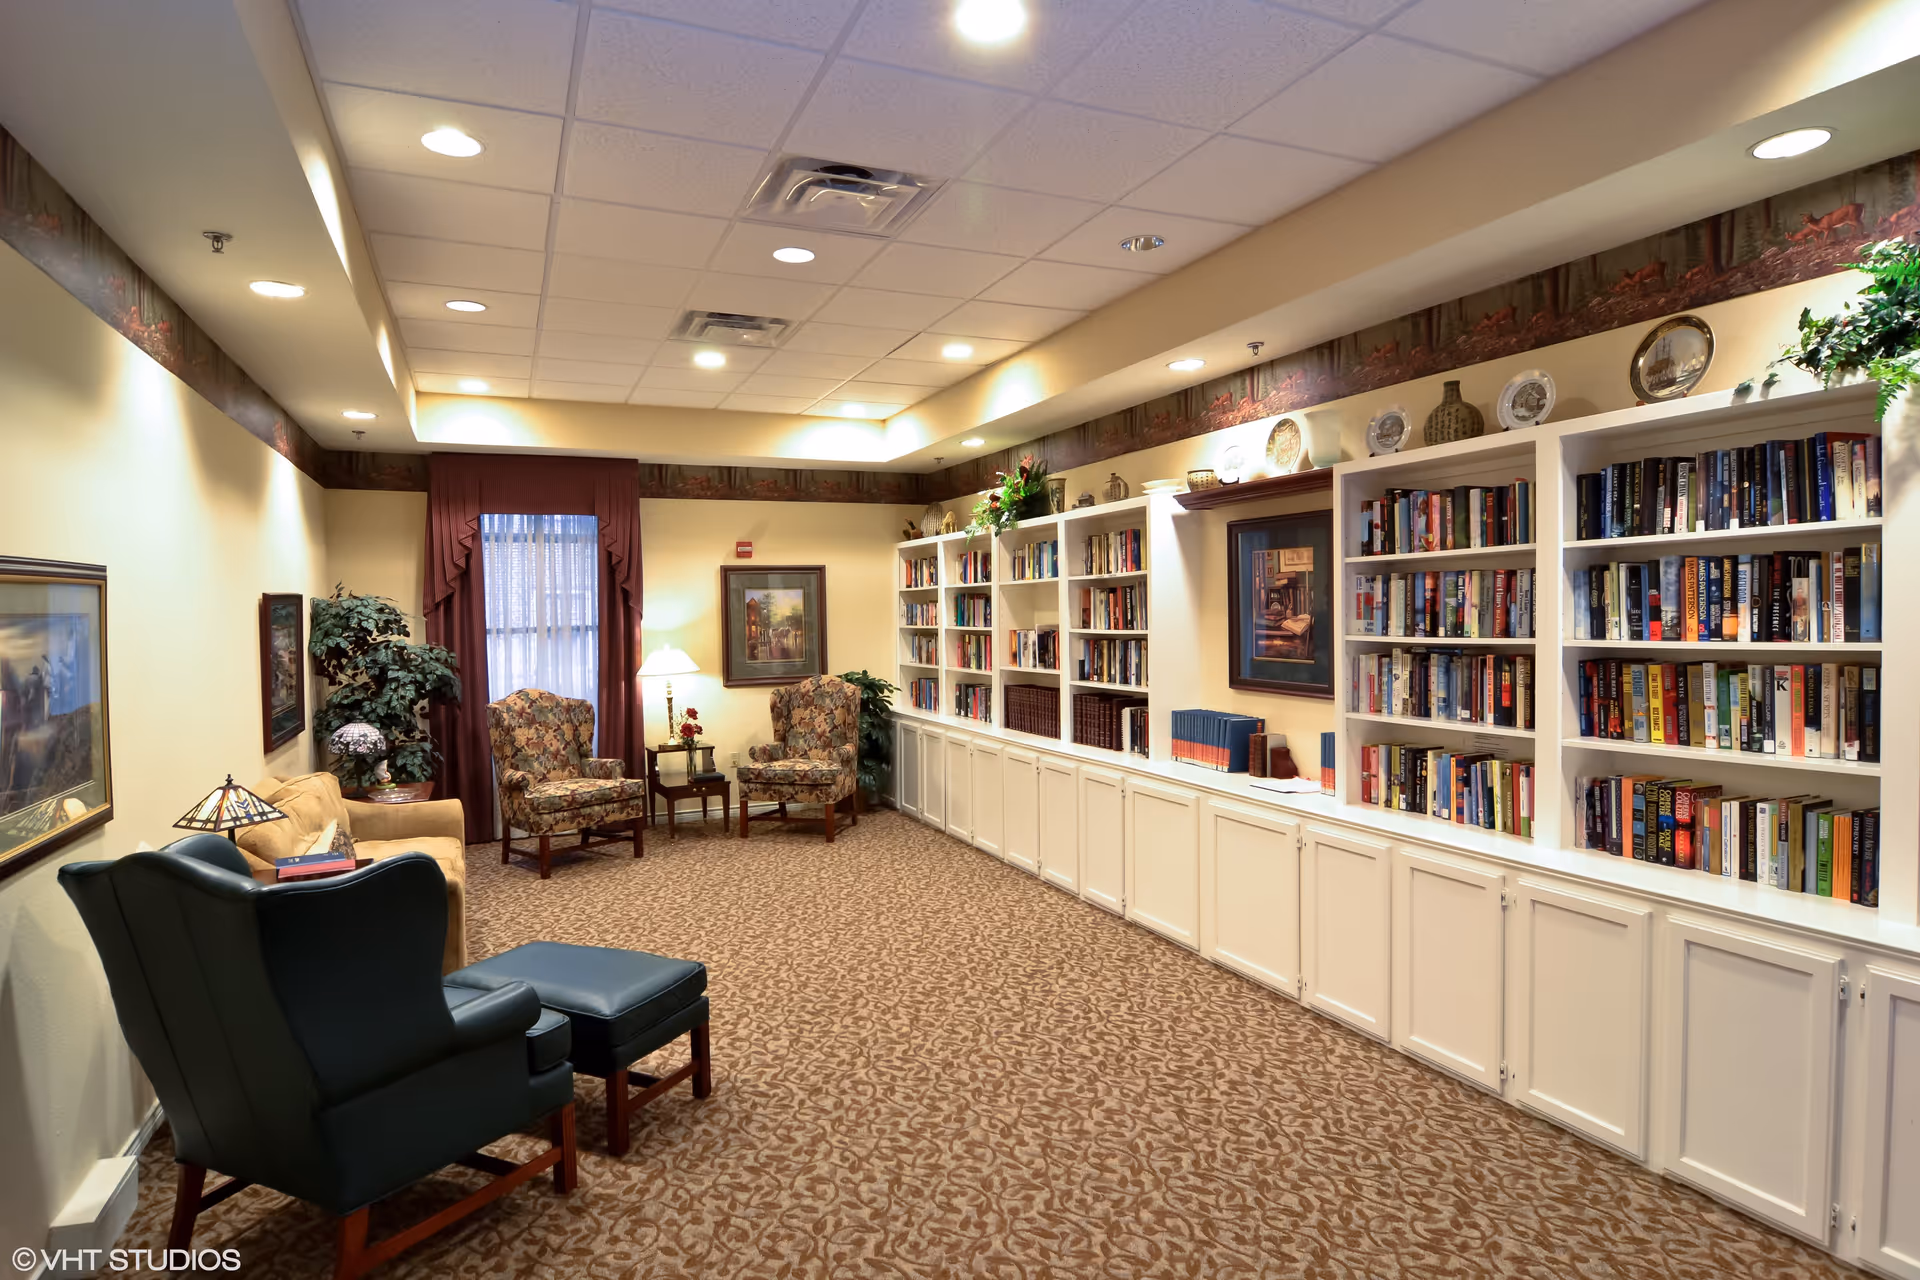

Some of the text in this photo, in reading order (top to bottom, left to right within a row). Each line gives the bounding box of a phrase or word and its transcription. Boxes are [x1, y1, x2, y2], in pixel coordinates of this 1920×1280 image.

[1496, 574, 1504, 587] Tom
[1687, 560, 1695, 581] JAMES
[1495, 588, 1504, 608] Clancy
[1688, 582, 1696, 619] PATTERSON
[1777, 680, 1788, 691] K
[1646, 786, 1658, 801] ICON
[1664, 790, 1672, 816] CATHERINE
[1682, 792, 1690, 820] CATHERINE
[1648, 804, 1656, 832] FREDERICK
[1864, 817, 1874, 838] JEFFREY
[1864, 838, 1874, 860] ARCHER
